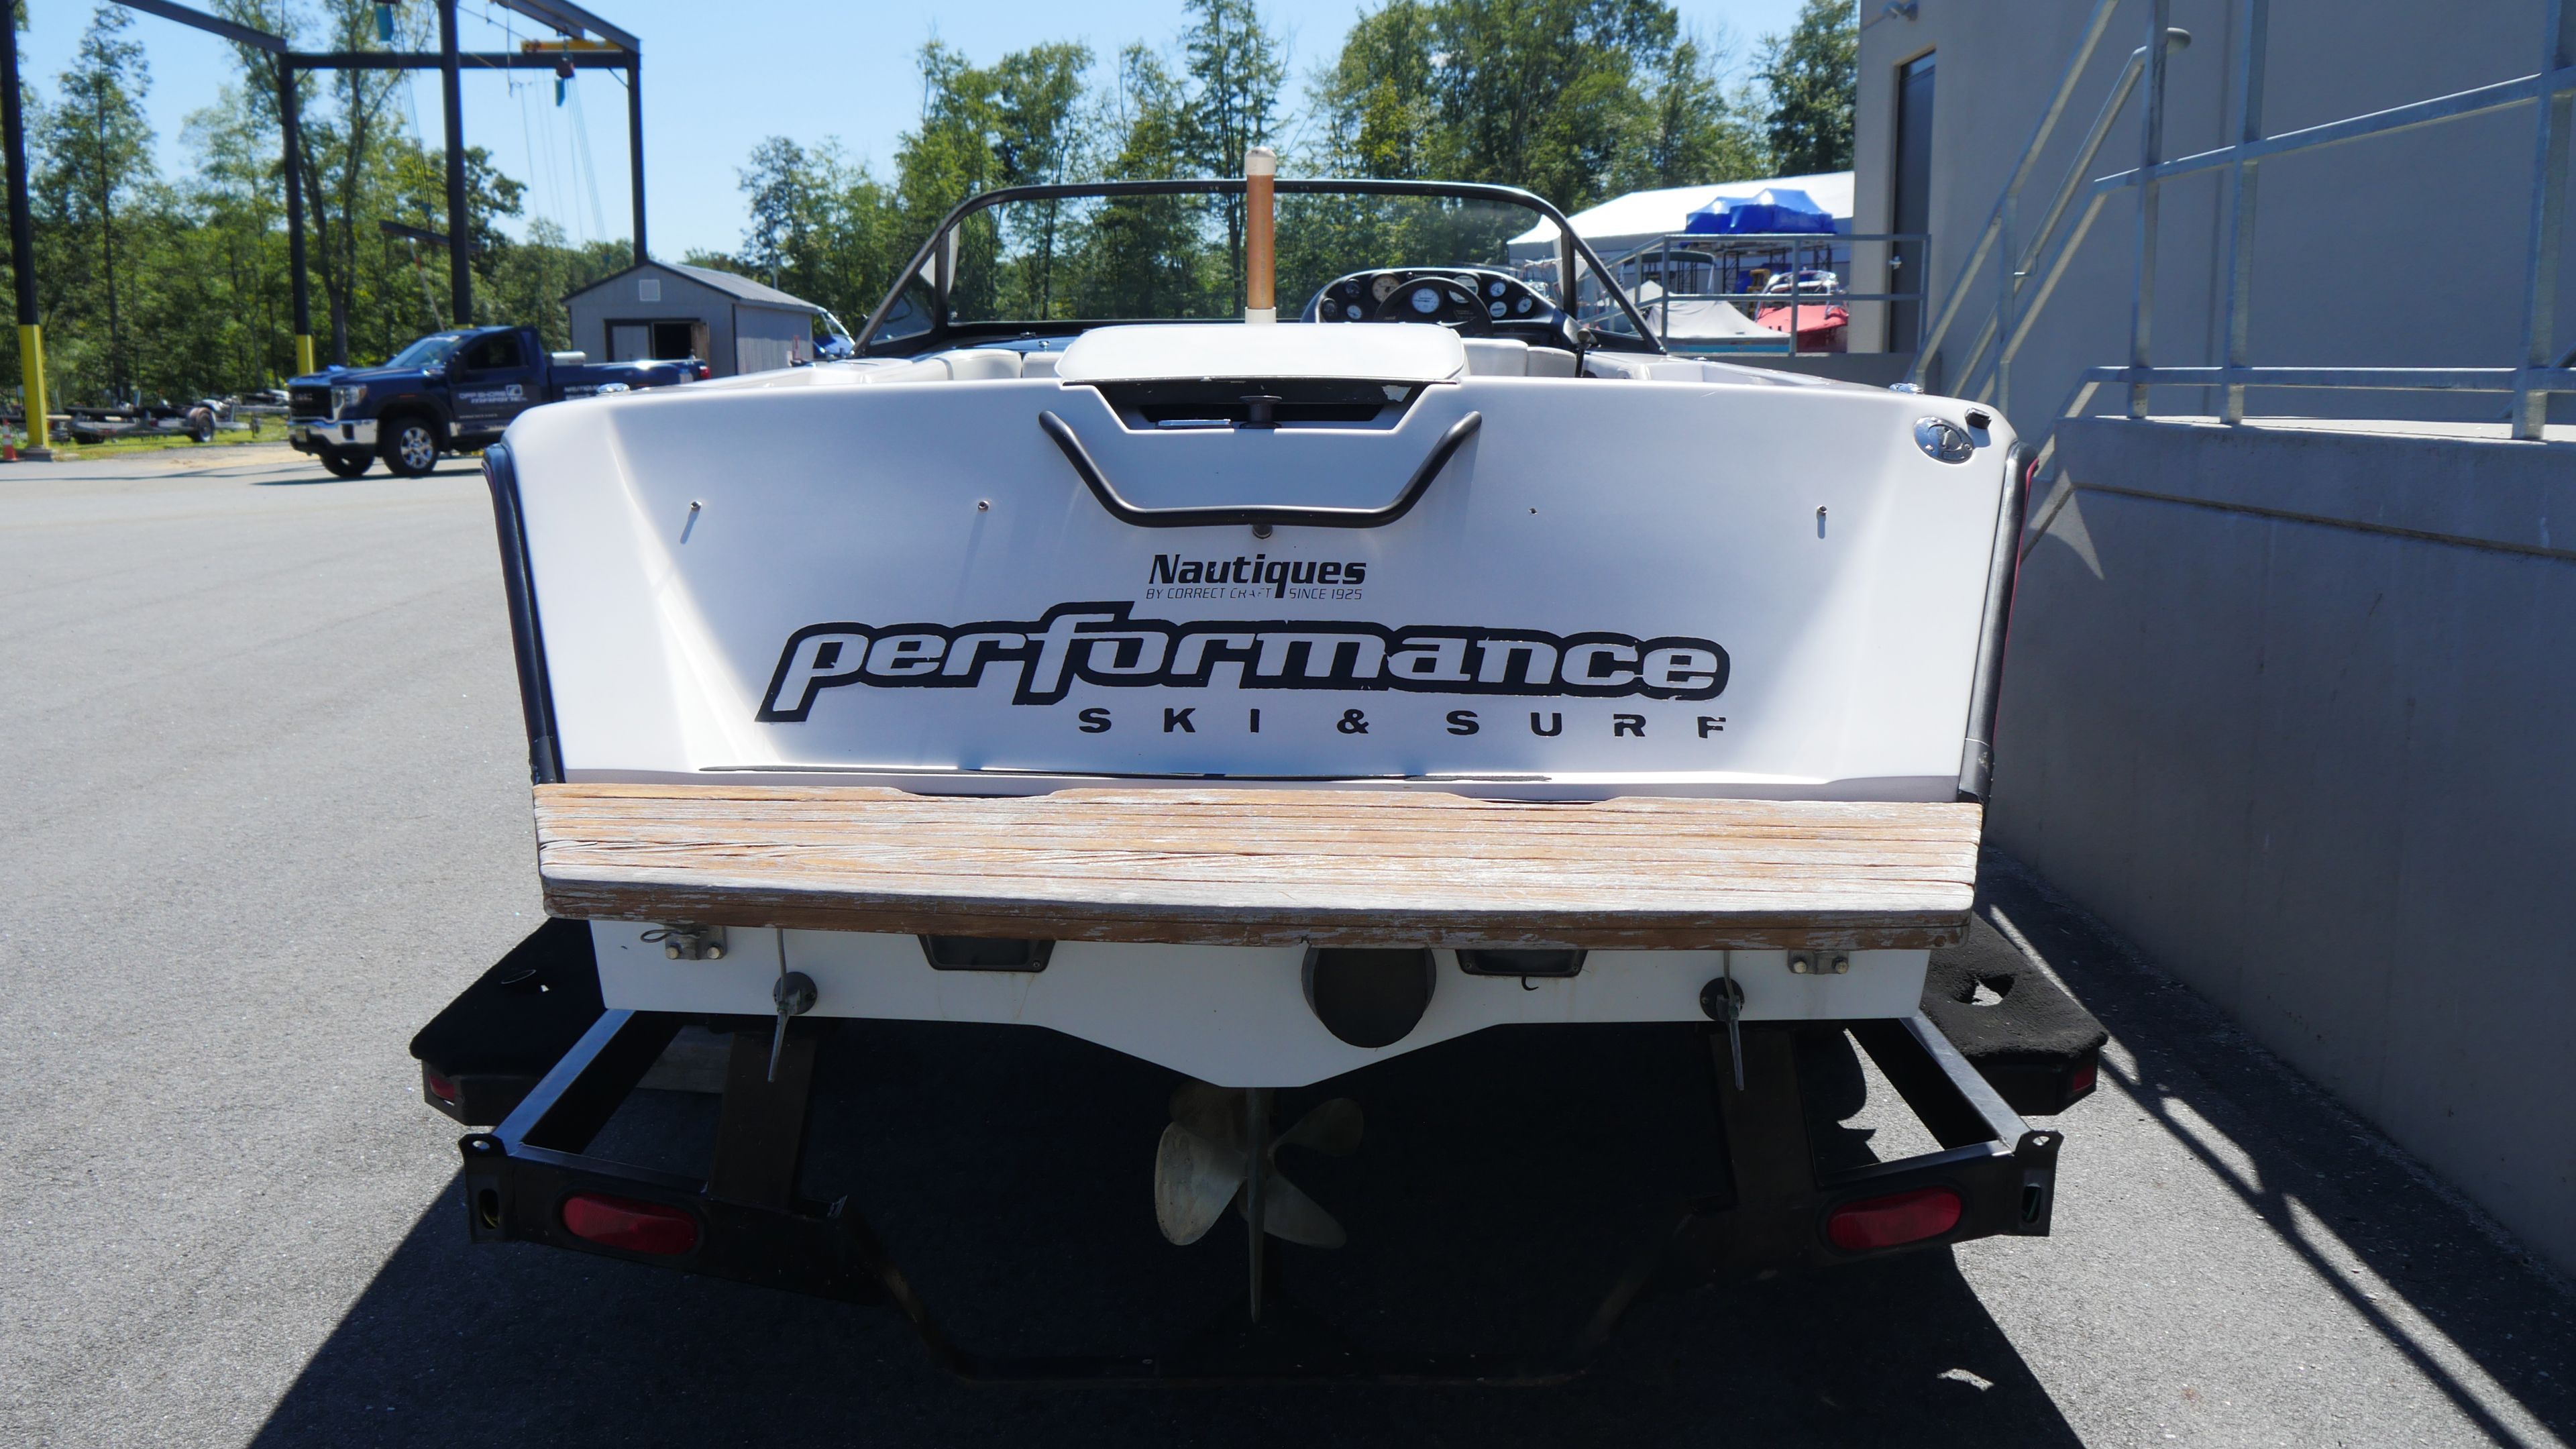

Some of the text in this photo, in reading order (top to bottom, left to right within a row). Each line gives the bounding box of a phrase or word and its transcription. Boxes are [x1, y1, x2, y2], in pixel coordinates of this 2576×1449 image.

[1146, 588, 1164, 600] BY
[1167, 588, 1226, 599] CORRECT
[1289, 588, 1327, 600] SINCE
[1331, 588, 1362, 600] 1925
[1148, 553, 1367, 599] Nautiques
[757, 600, 1731, 722] performance
[1078, 707, 1726, 739] SKI & SURF
